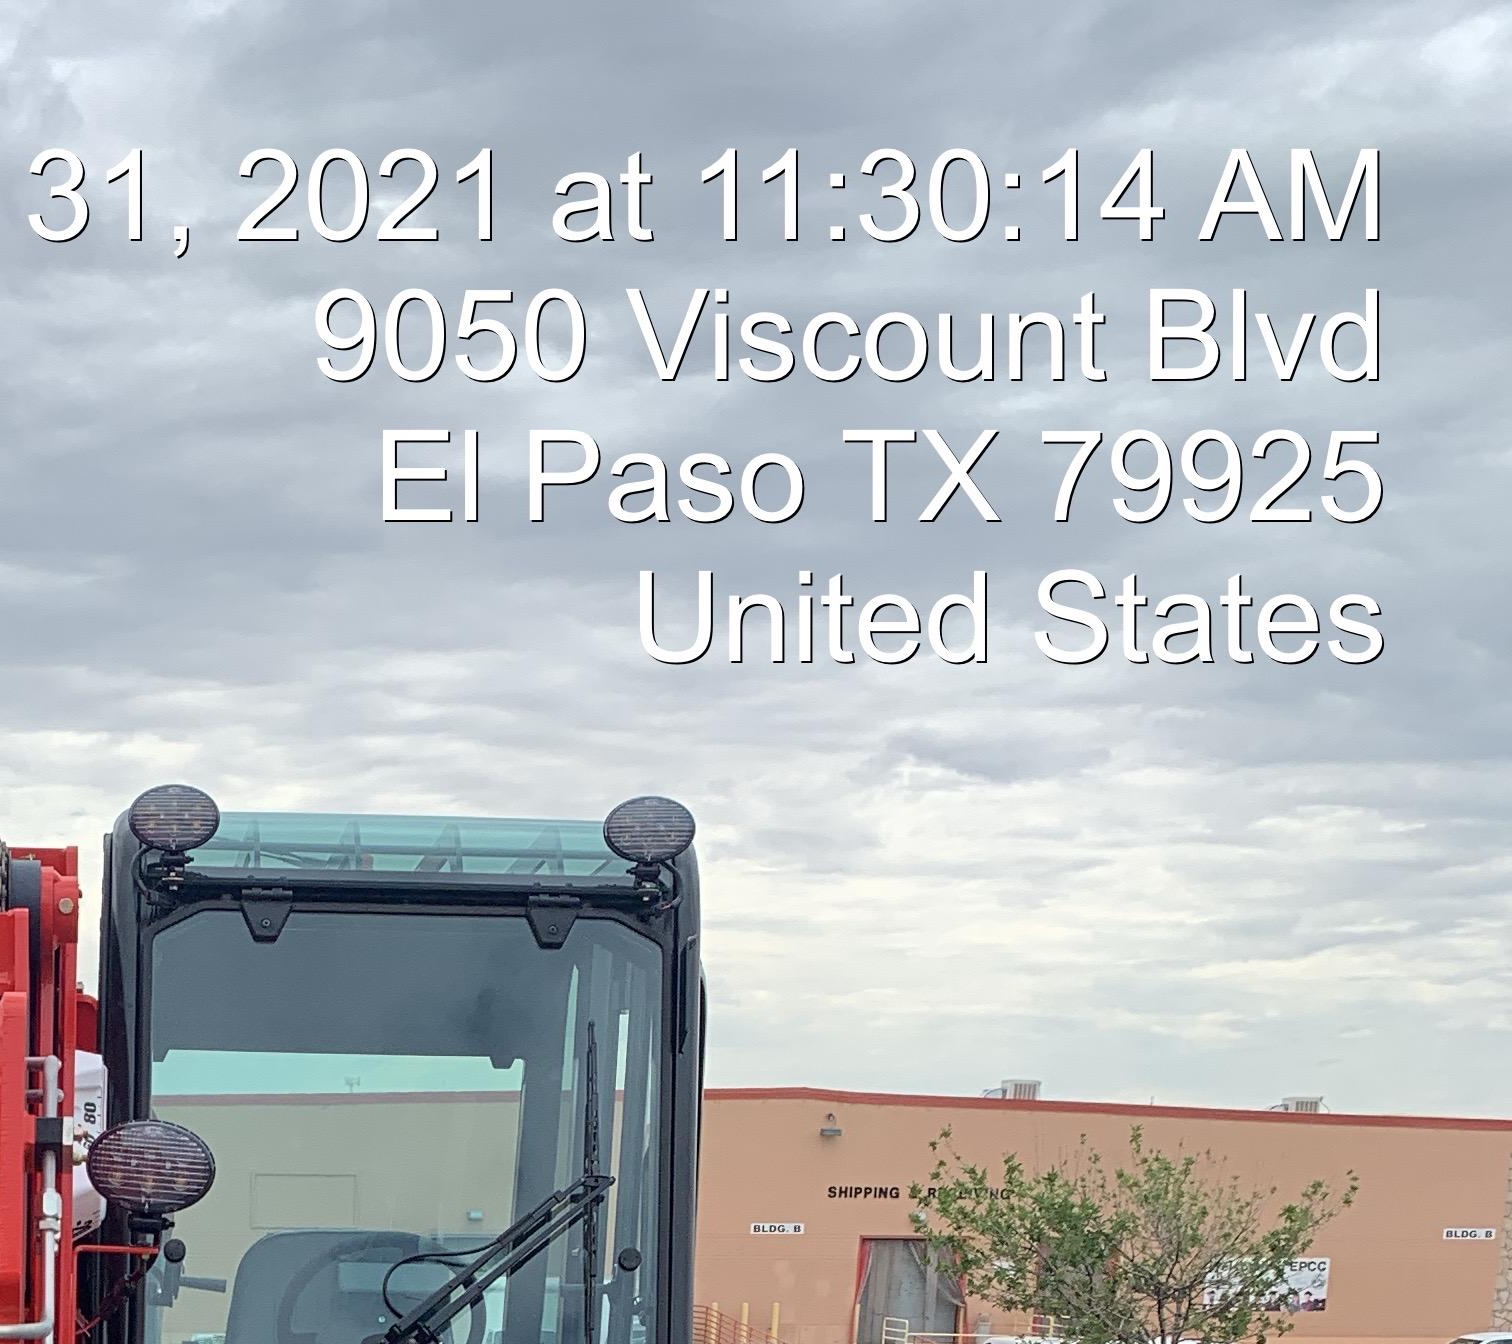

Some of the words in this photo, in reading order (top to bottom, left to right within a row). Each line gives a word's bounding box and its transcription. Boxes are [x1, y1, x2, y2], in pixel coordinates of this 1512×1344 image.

[827, 1186, 900, 1199] SHIPPING
[753, 1224, 790, 1233] BLDG.
[793, 1224, 802, 1233] B
[1445, 1230, 1481, 1238] BLDG.
[1484, 1230, 1493, 1238] B
[1290, 1261, 1327, 1272] EPCC
